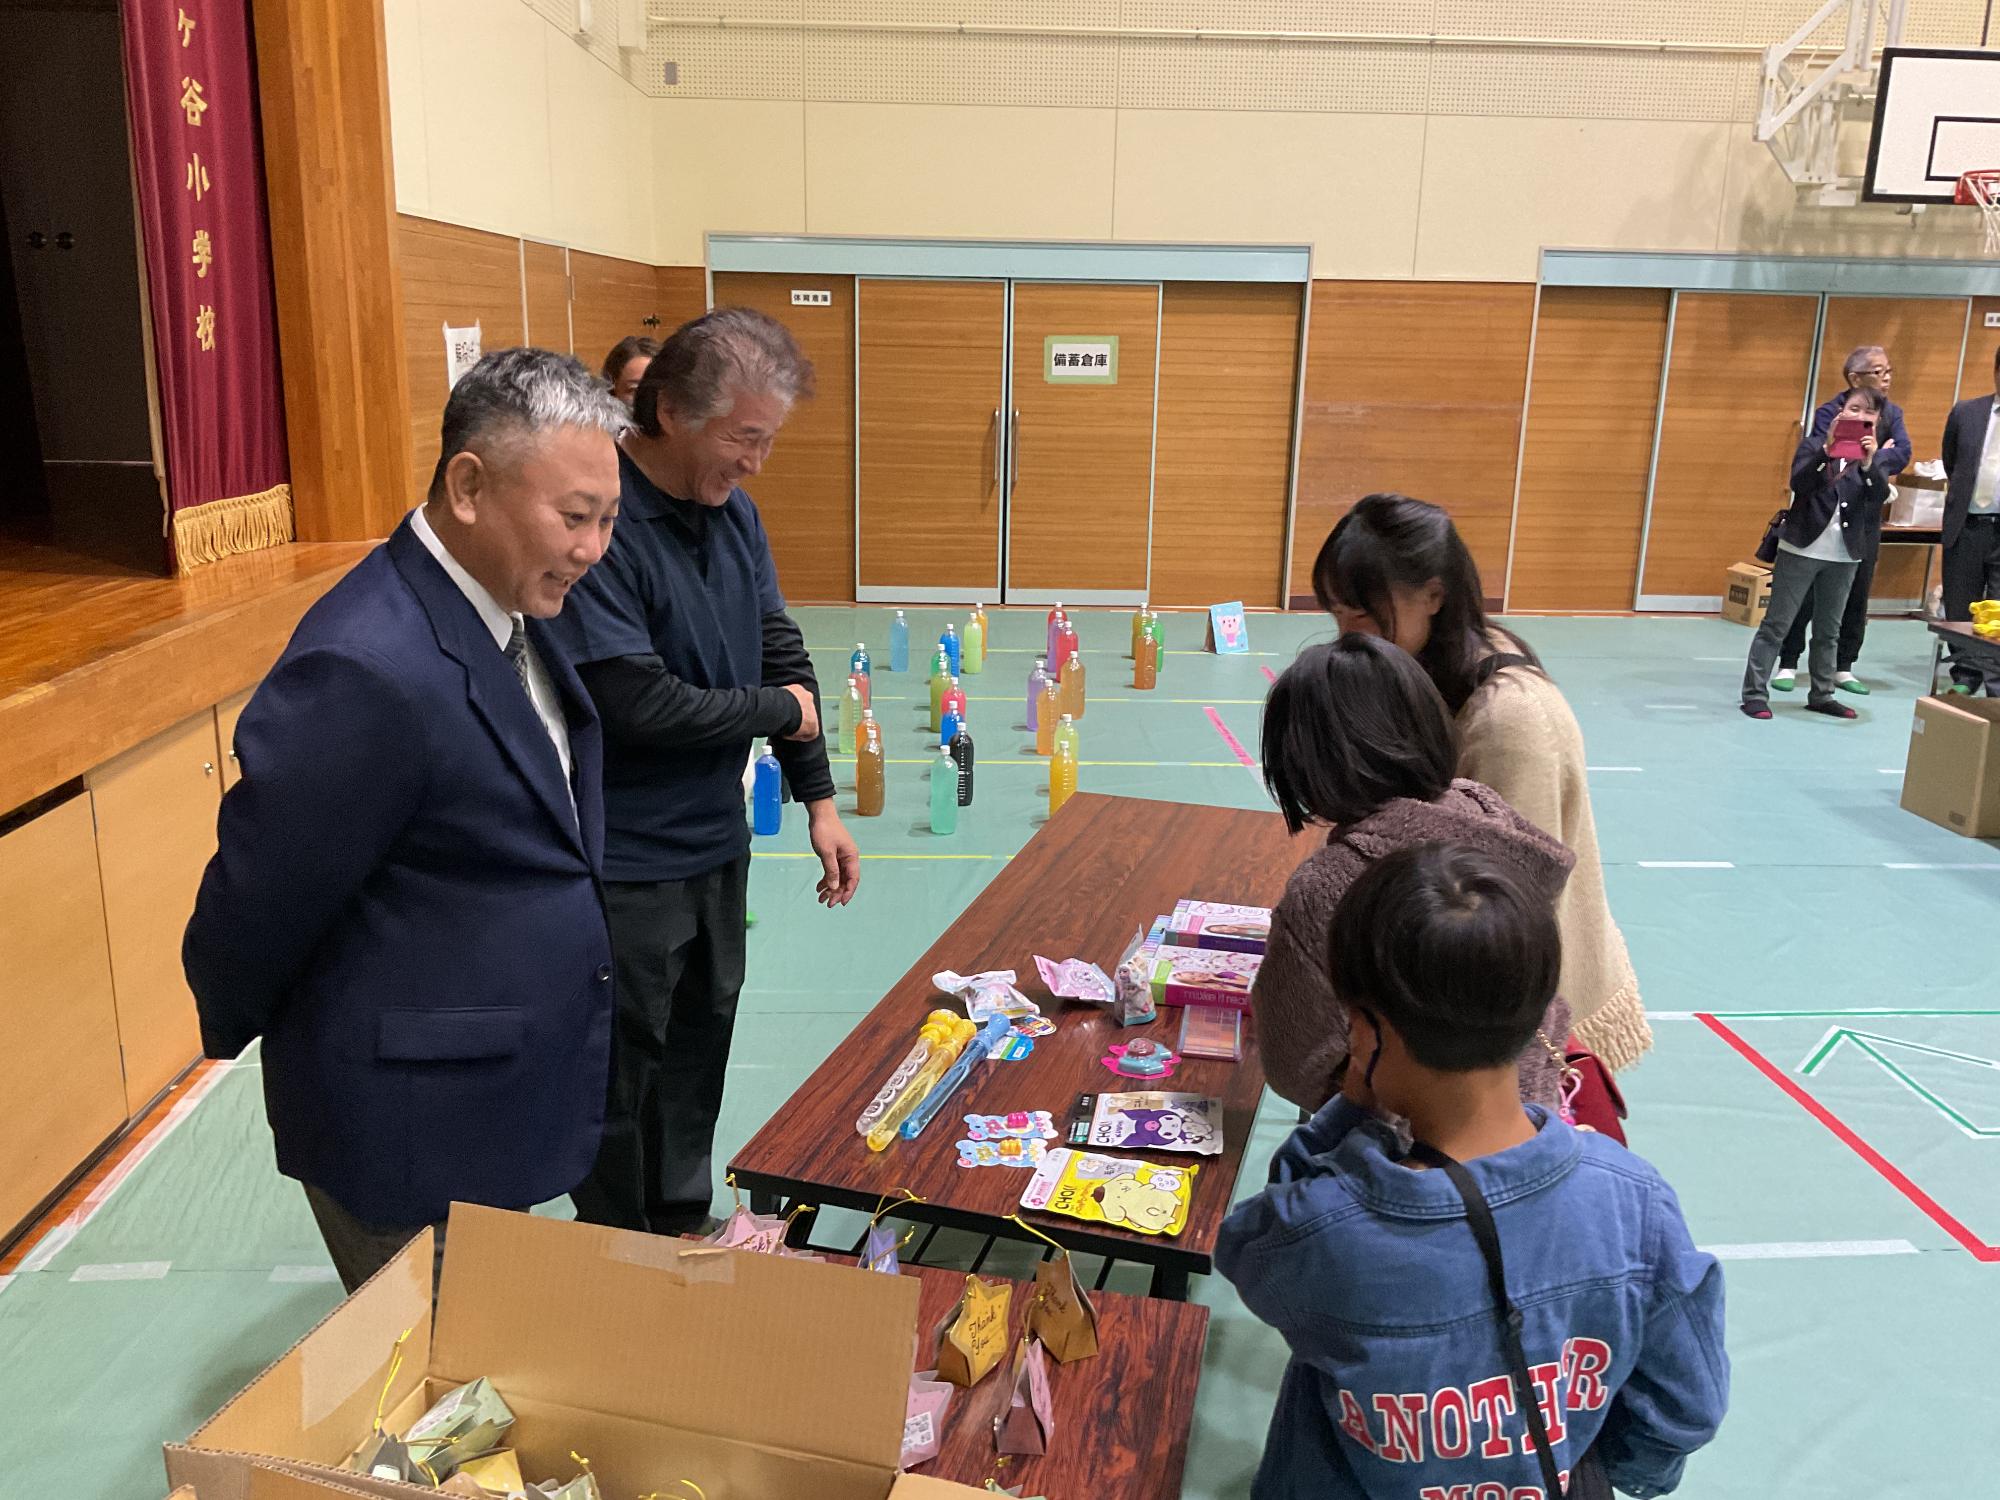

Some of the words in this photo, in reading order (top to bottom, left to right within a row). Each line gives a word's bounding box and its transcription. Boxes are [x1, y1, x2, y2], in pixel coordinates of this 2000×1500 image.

[178, 8, 216, 351] ケ谷小学校
[1054, 353, 1108, 367] 備蓄倉庫
[969, 1305, 996, 1339] Thank
[971, 1337, 989, 1355] You
